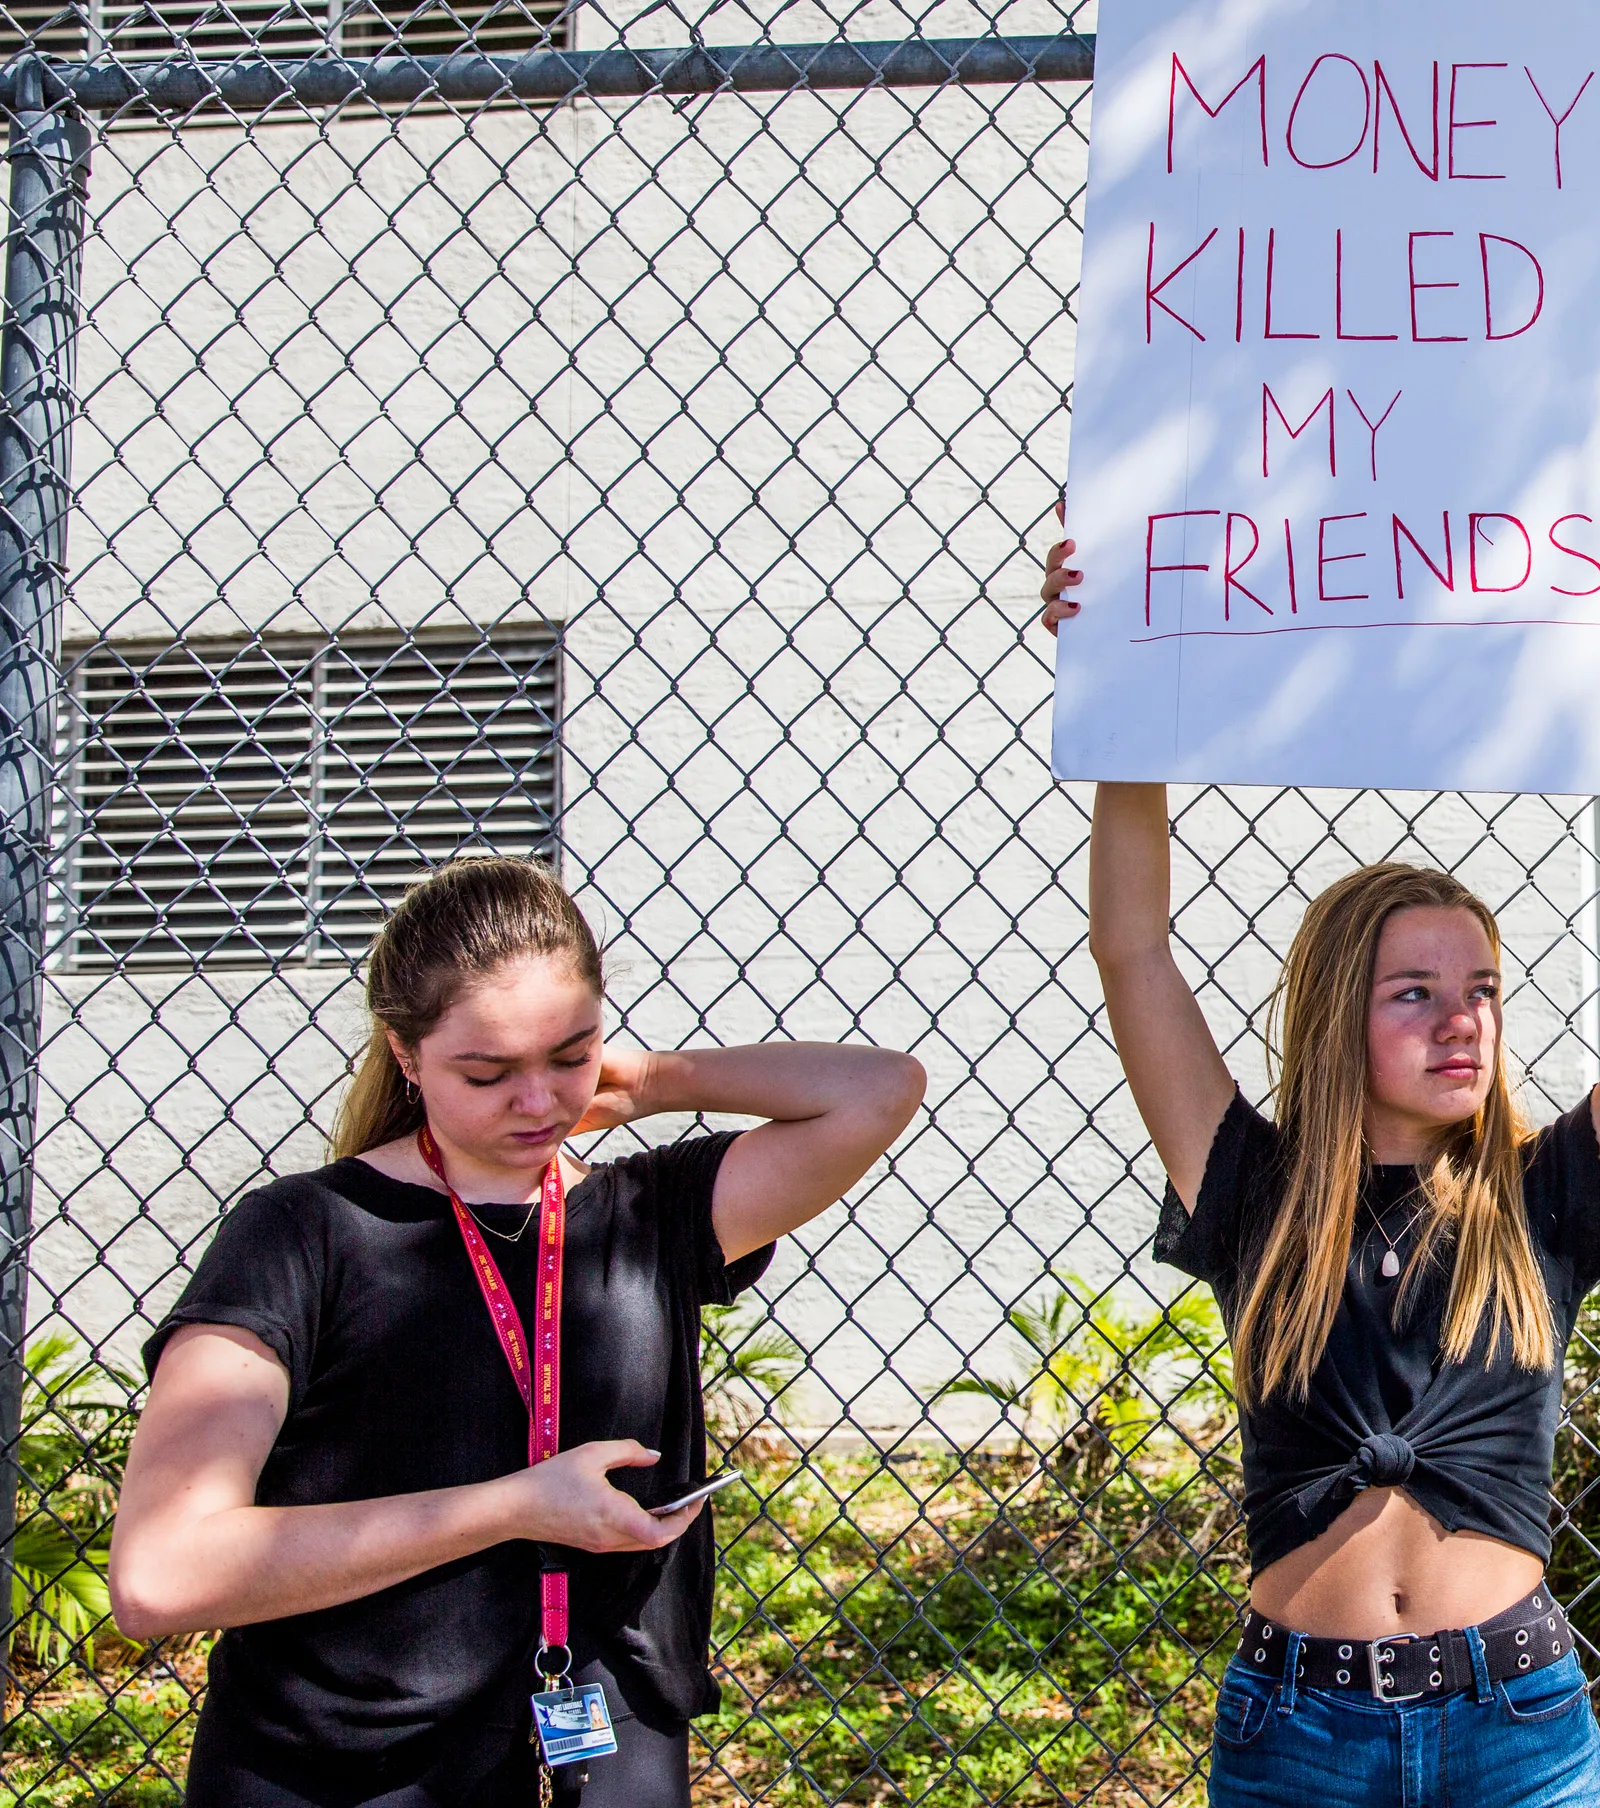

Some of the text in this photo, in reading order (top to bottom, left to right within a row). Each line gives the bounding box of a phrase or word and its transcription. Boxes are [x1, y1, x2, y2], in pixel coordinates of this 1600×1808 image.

[1166, 51, 1596, 190] MONEY
[1145, 221, 1545, 345] KILLED
[1261, 381, 1403, 482] MY
[543, 1281, 553, 1320] USC TROJANS
[507, 1329, 523, 1369] USC TROJANS
[543, 1363, 551, 1405] USC TROJANS
